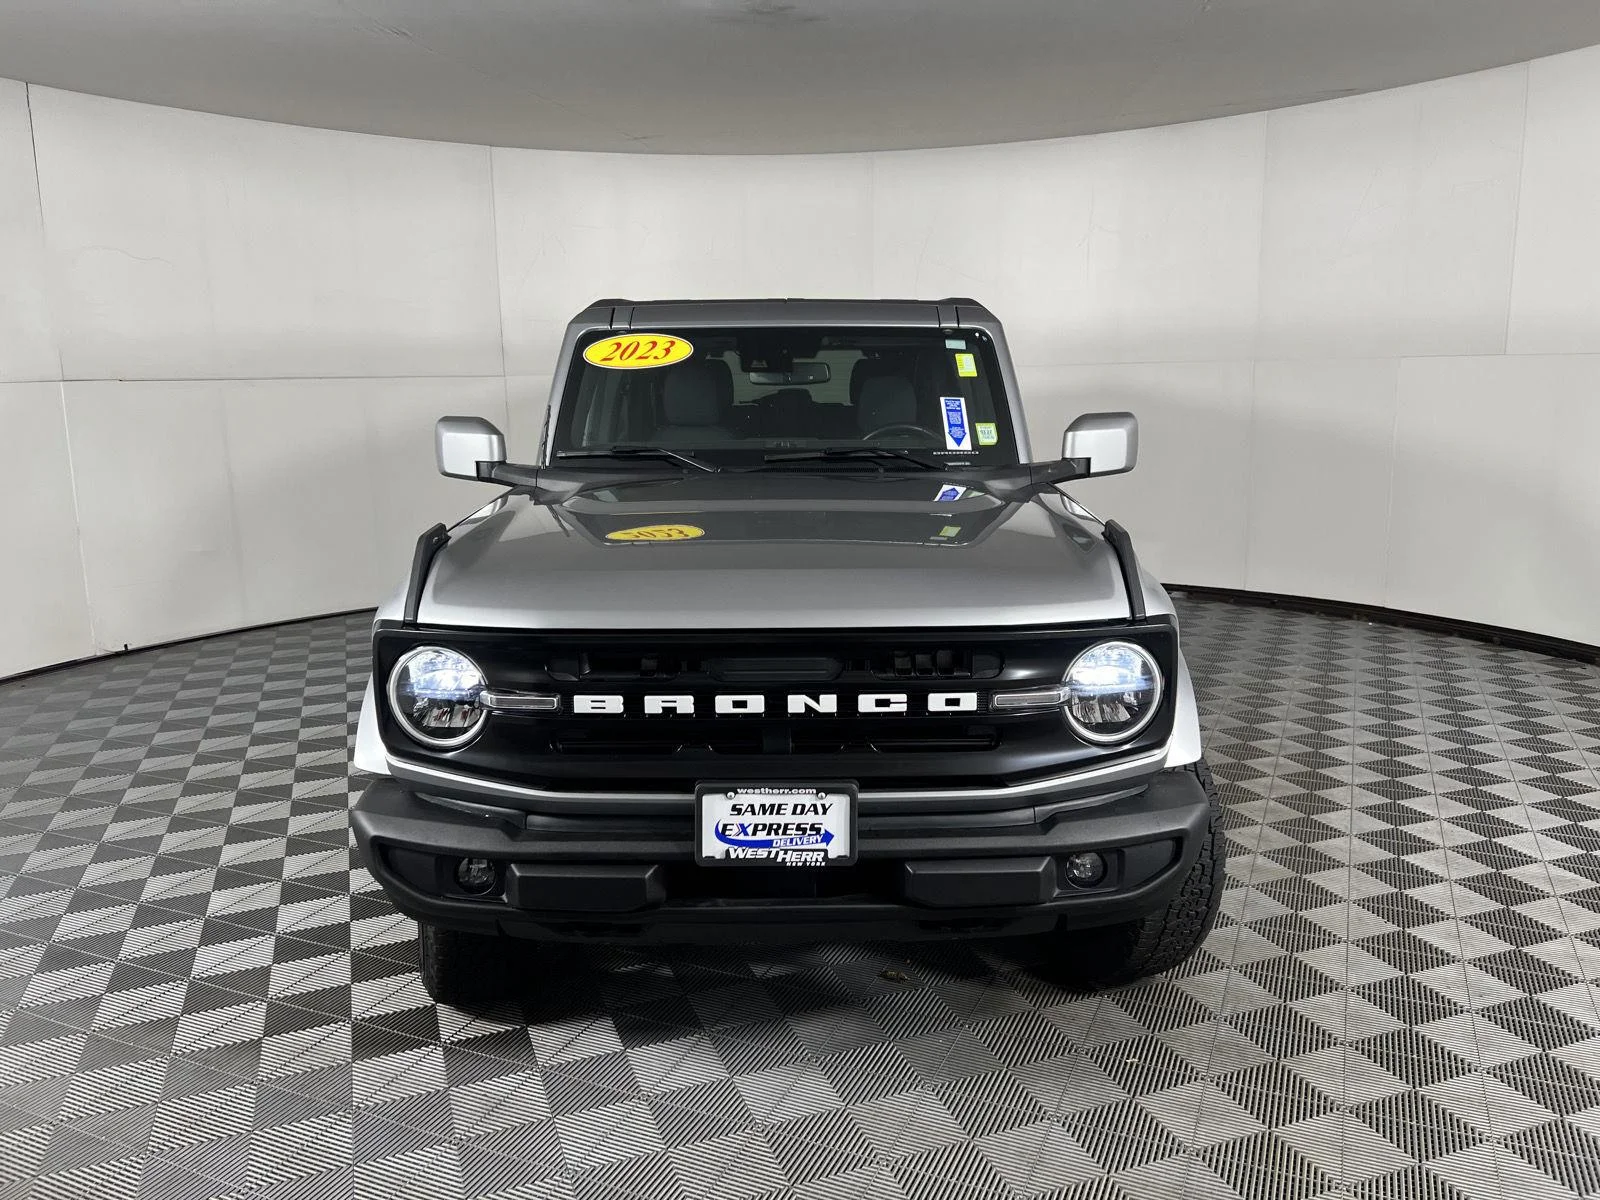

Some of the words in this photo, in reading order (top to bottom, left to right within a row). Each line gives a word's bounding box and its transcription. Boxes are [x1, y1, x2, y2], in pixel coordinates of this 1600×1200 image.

[600, 340, 676, 362] 2023
[573, 692, 978, 714] BRONCO
[736, 787, 817, 795] westherr.com
[729, 803, 788, 816] SAME
[791, 803, 834, 816] DAY
[721, 823, 823, 836] EXPRESS
[772, 835, 824, 848] DELIVERY
